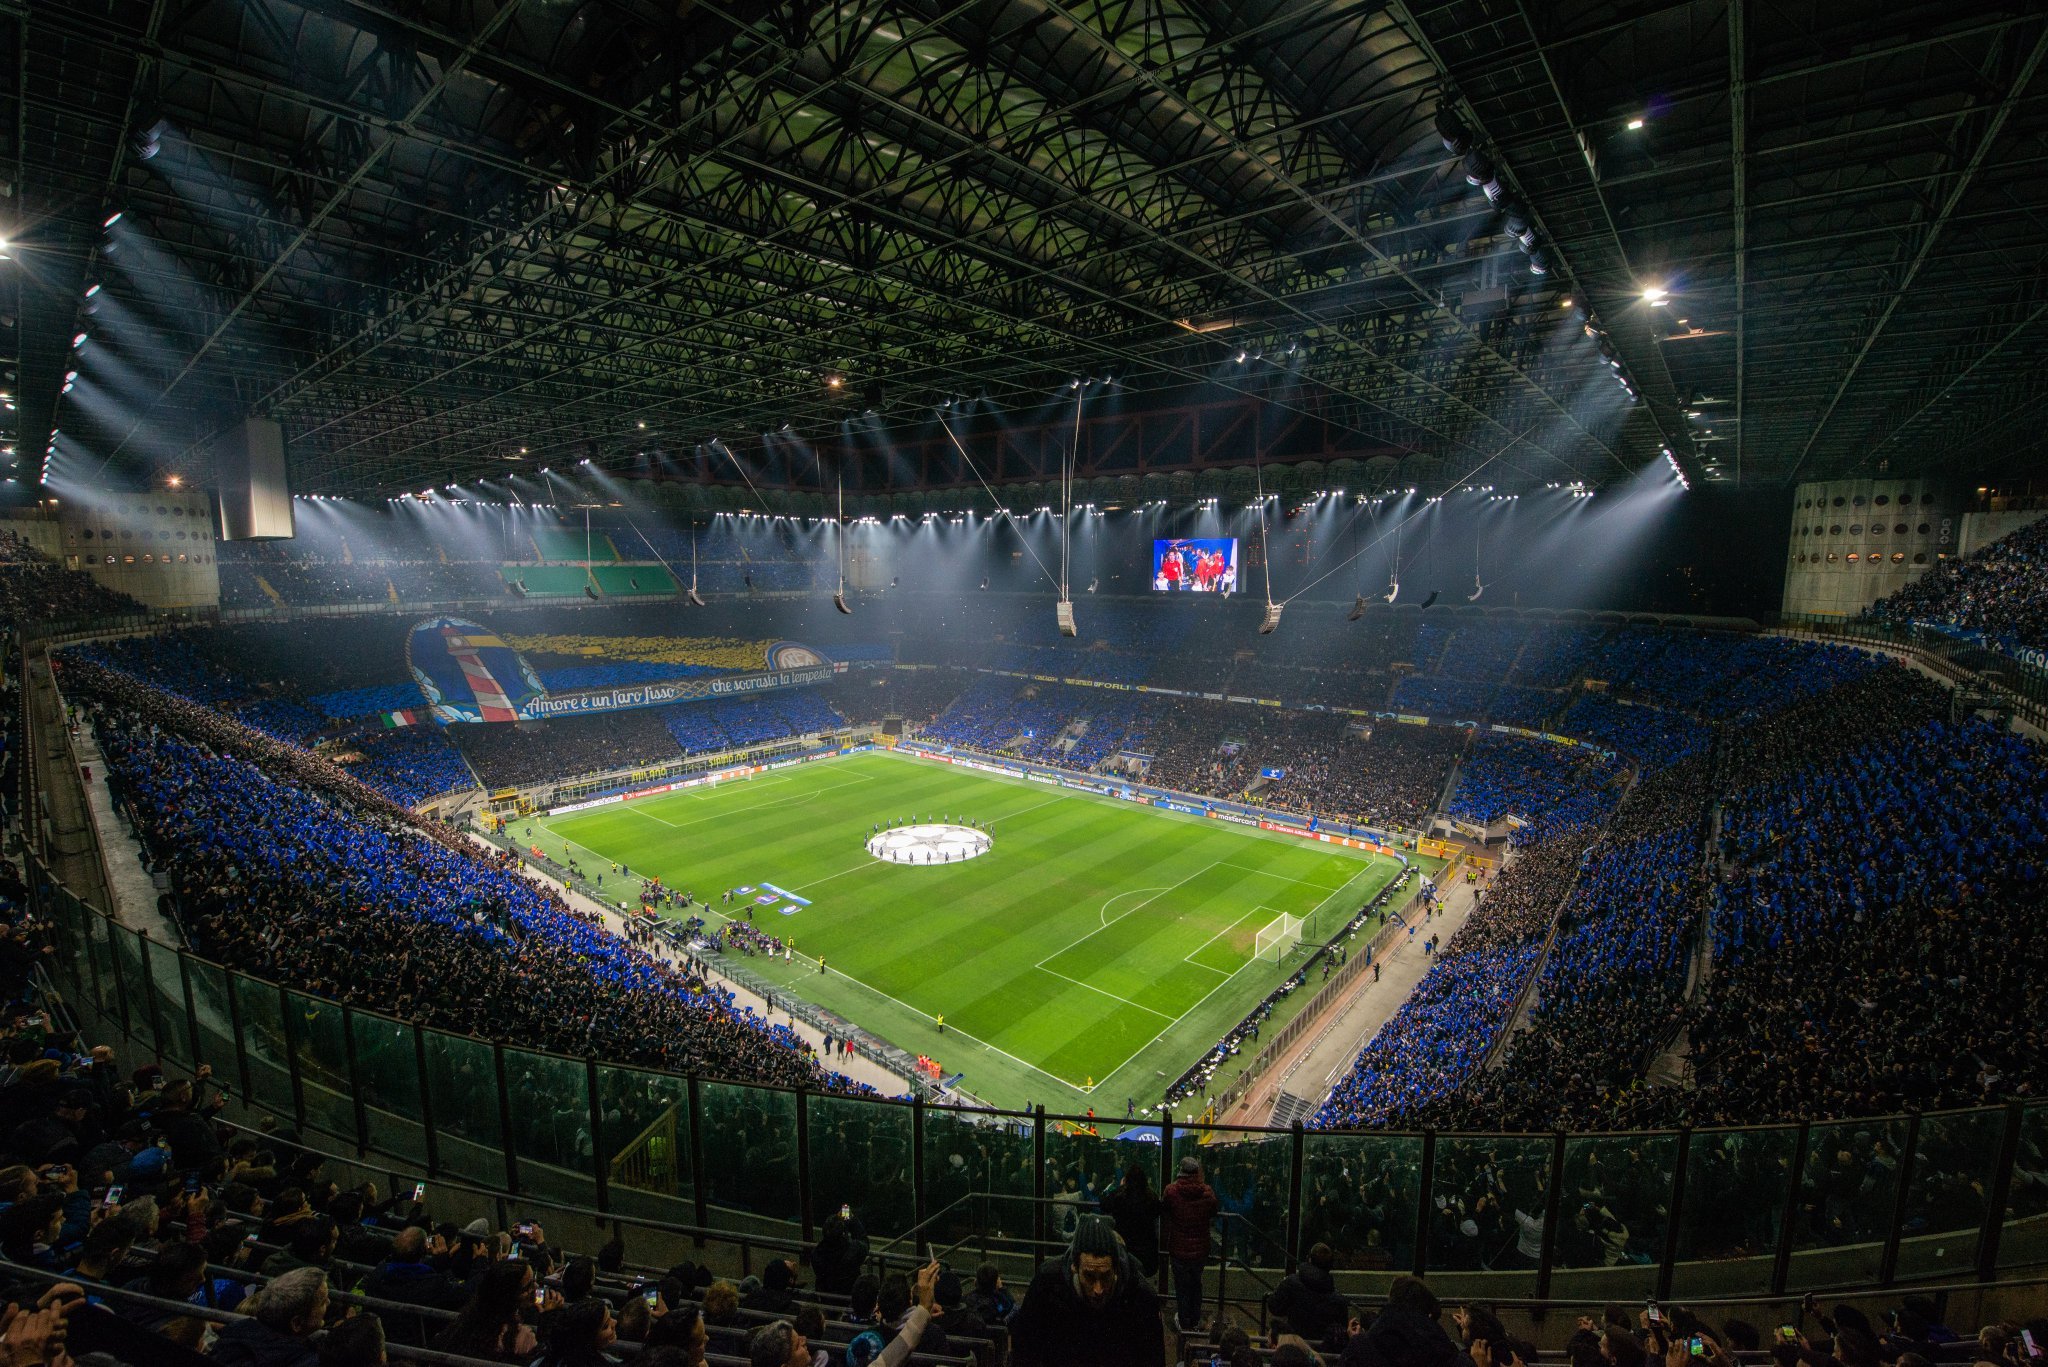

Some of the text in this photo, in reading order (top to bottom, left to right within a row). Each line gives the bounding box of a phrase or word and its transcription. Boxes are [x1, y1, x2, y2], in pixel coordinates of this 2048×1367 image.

[526, 667, 832, 714] Amore è un faro fisso che sovrasta la tempesta
[1218, 812, 1257, 827] mastercard
